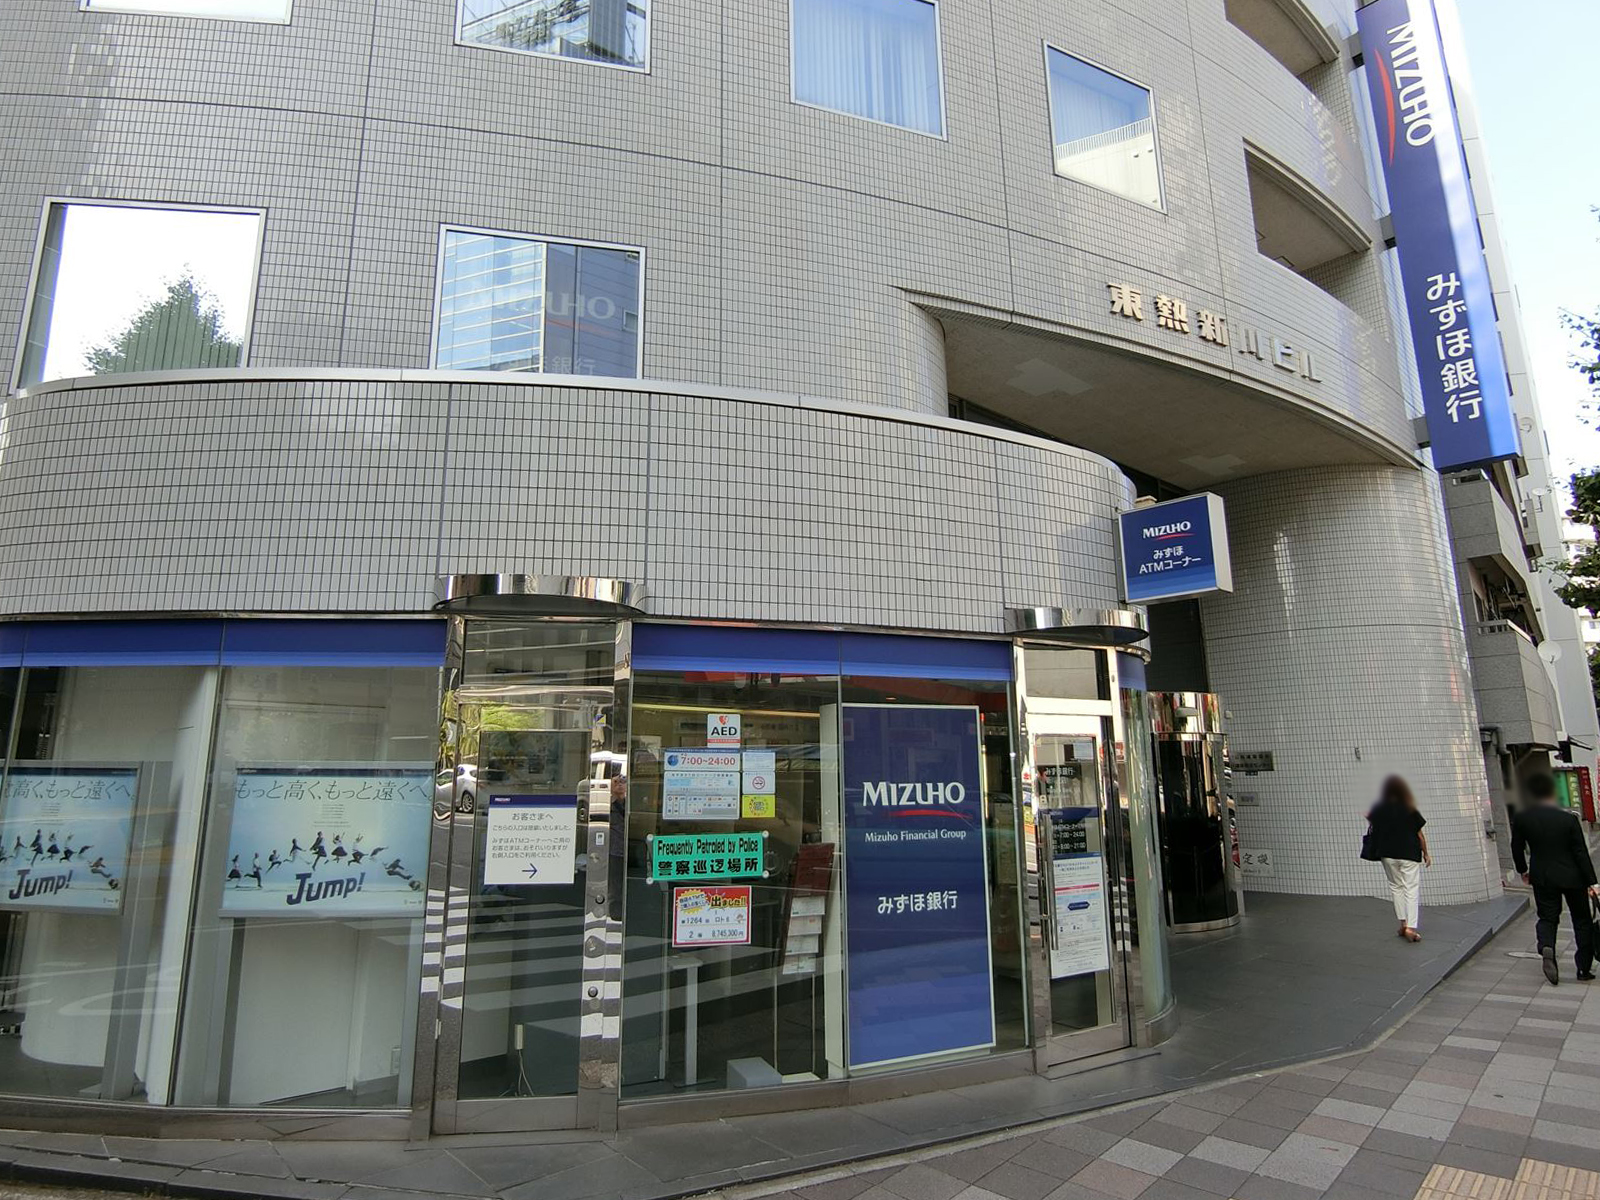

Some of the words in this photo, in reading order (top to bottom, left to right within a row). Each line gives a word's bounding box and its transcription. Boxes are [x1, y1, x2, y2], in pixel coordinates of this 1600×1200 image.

[1386, 21, 1436, 147] MIZUHO
[1106, 282, 1322, 383] 東熱新川ビル
[1425, 272, 1483, 423] みずほ銀行
[1142, 521, 1192, 539] MIZUHO
[1153, 545, 1184, 560] みずほ
[1139, 556, 1202, 574] ATMコーナー
[710, 726, 738, 736] AED
[863, 781, 966, 807] MIZUHO
[512, 812, 554, 821] お客さまへ
[865, 831, 899, 843] Mizuho
[900, 829, 939, 842] Financial
[940, 828, 967, 841] Group
[657, 839, 694, 856] Frequently
[727, 838, 737, 854] by
[738, 837, 759, 853] Police
[9, 868, 74, 900] Jump!
[286, 871, 367, 906] Jump!
[877, 890, 958, 914] みずほ銀行
